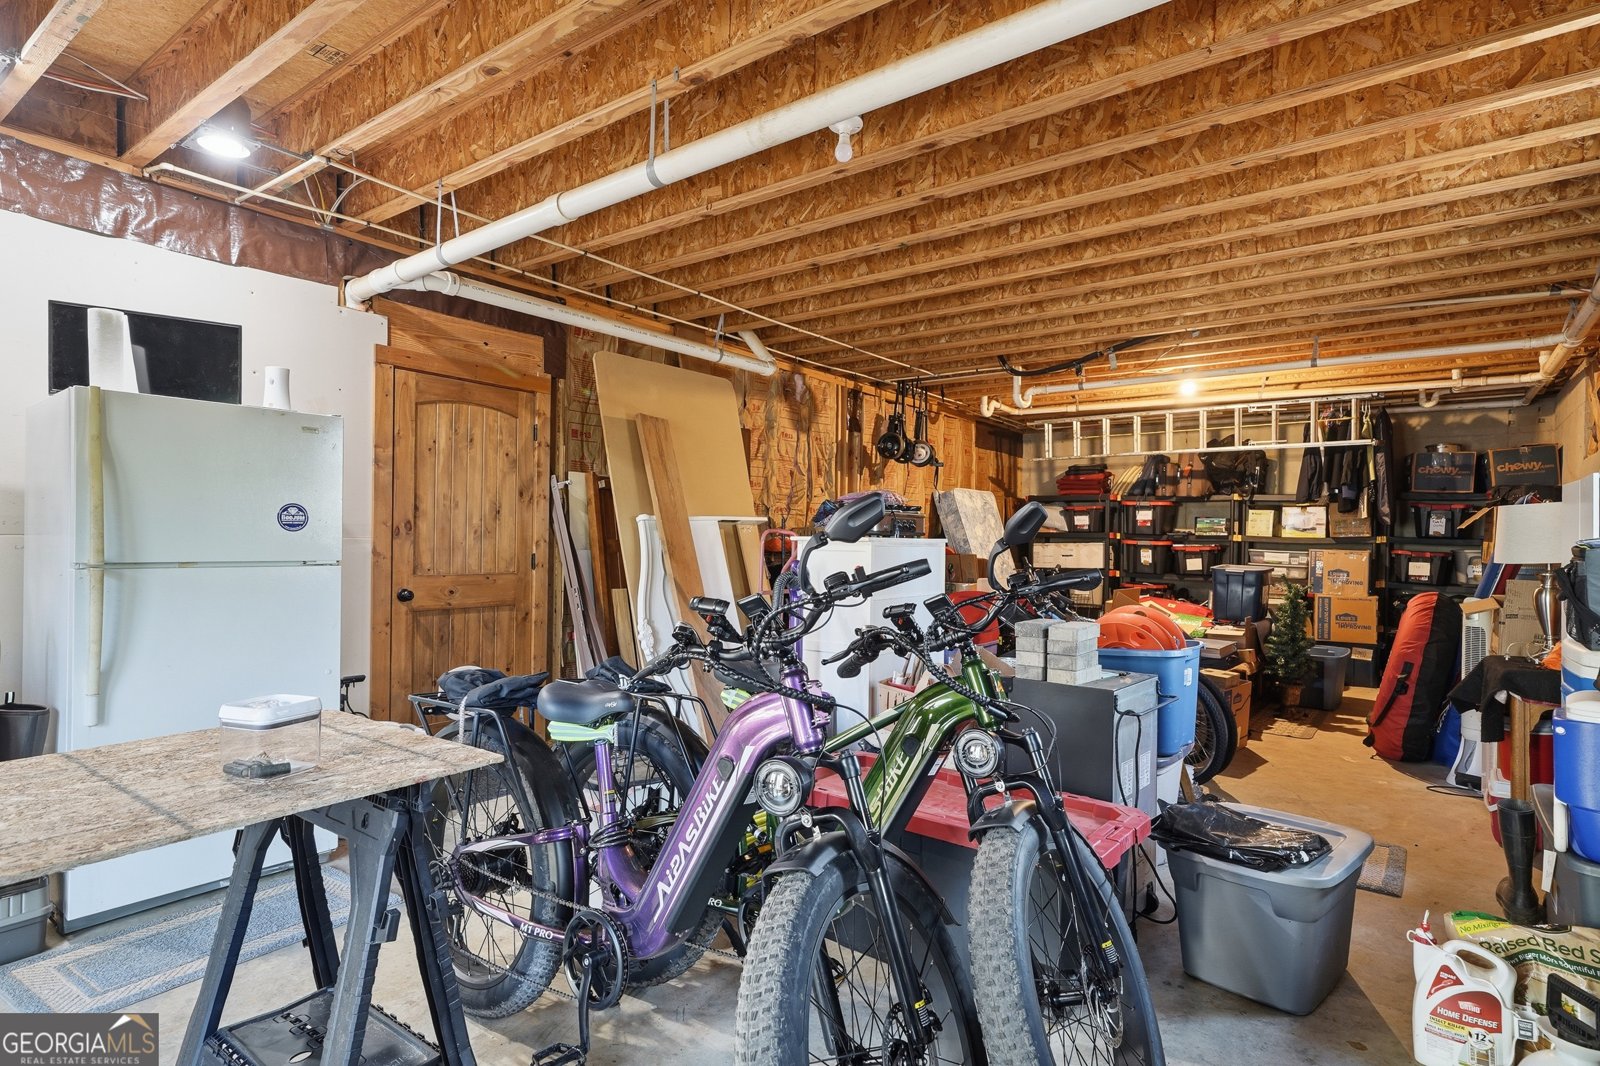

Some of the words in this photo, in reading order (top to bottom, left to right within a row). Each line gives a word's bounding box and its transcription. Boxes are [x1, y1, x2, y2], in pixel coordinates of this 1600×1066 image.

[707, 897, 722, 907] RO
[520, 922, 533, 934] M1
[533, 927, 554, 939] PRO
[1460, 925, 1472, 933] No
[1479, 934, 1541, 955] Raised
[1541, 937, 1586, 960] Bed
[1437, 1006, 1461, 1020] HOME
[1462, 1013, 1499, 1029] DEFENSE
[1475, 1033, 1487, 1042] 12
